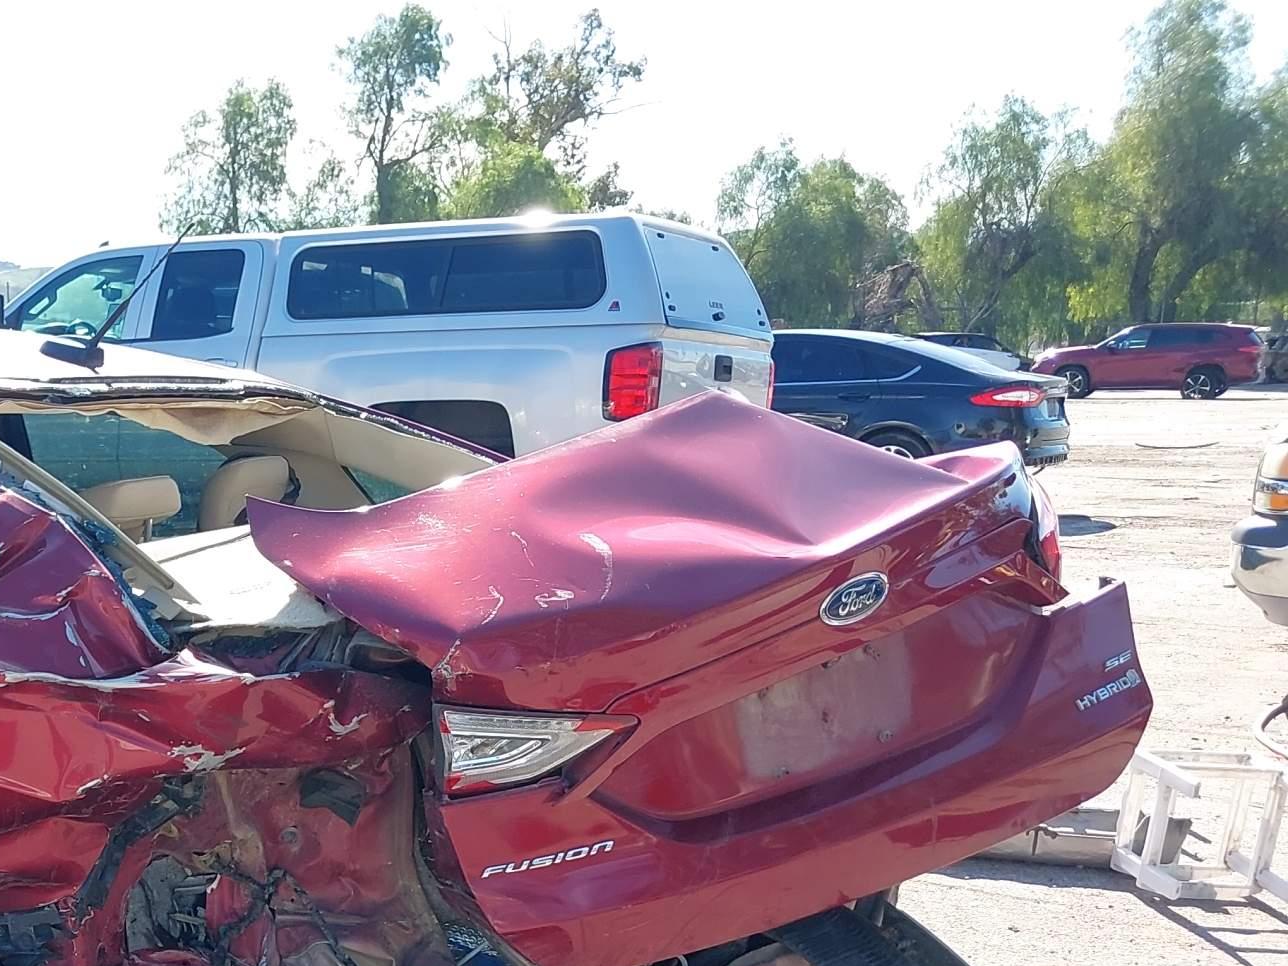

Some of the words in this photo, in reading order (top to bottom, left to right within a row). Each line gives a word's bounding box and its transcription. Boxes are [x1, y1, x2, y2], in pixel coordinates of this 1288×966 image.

[839, 584, 876, 616] Ford
[1104, 650, 1132, 672] SE
[1075, 676, 1131, 711] HYBRID
[481, 840, 614, 878] FUSION
